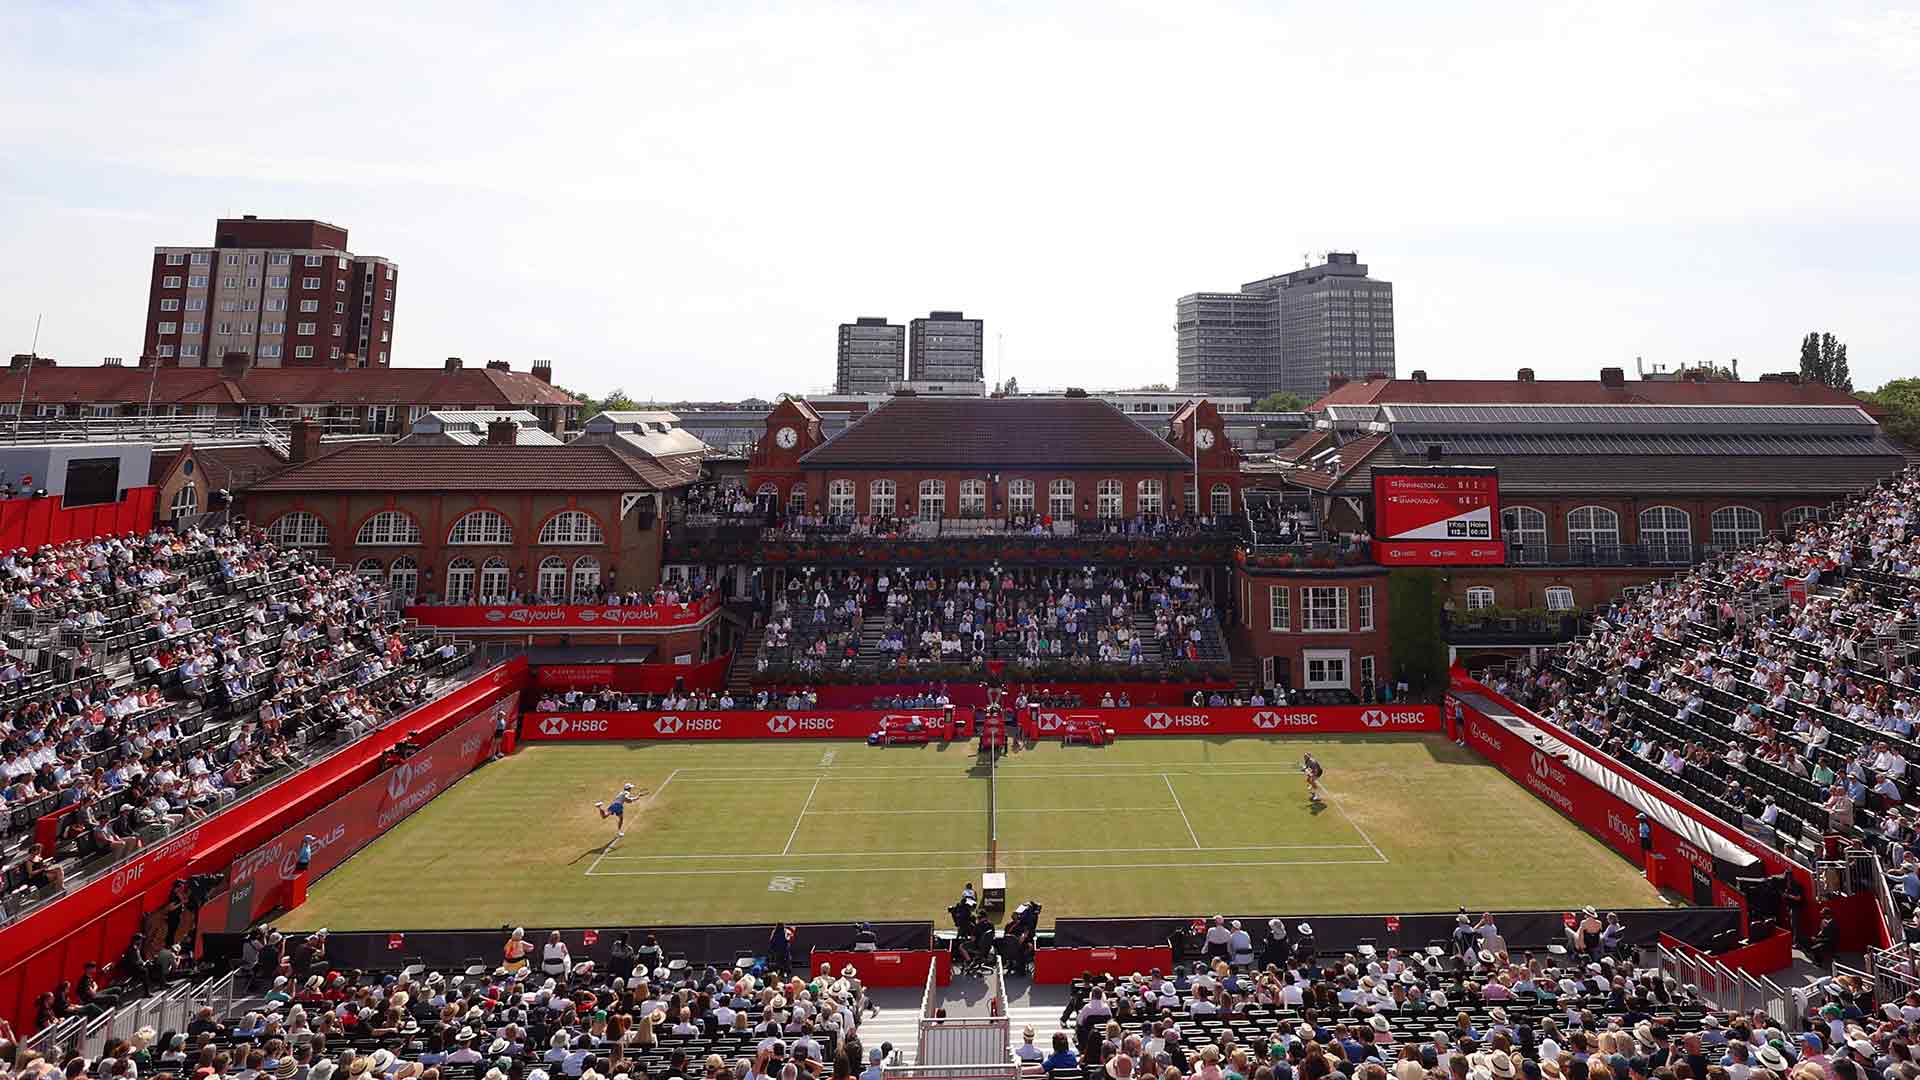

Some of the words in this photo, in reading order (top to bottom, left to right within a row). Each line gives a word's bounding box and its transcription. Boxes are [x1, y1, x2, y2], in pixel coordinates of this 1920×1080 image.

[528, 608, 566, 624] youth
[622, 608, 659, 624] youth
[686, 718, 722, 731] HSBC
[799, 717, 835, 730] HSBC
[1175, 714, 1210, 727] HSBC
[1283, 713, 1318, 726] HSBC
[1390, 712, 1425, 725] HSBC
[571, 719, 609, 732] HSBC
[1550, 768, 1567, 786] HSBC
[310, 823, 345, 857] EXUS
[126, 862, 145, 886] PIF
